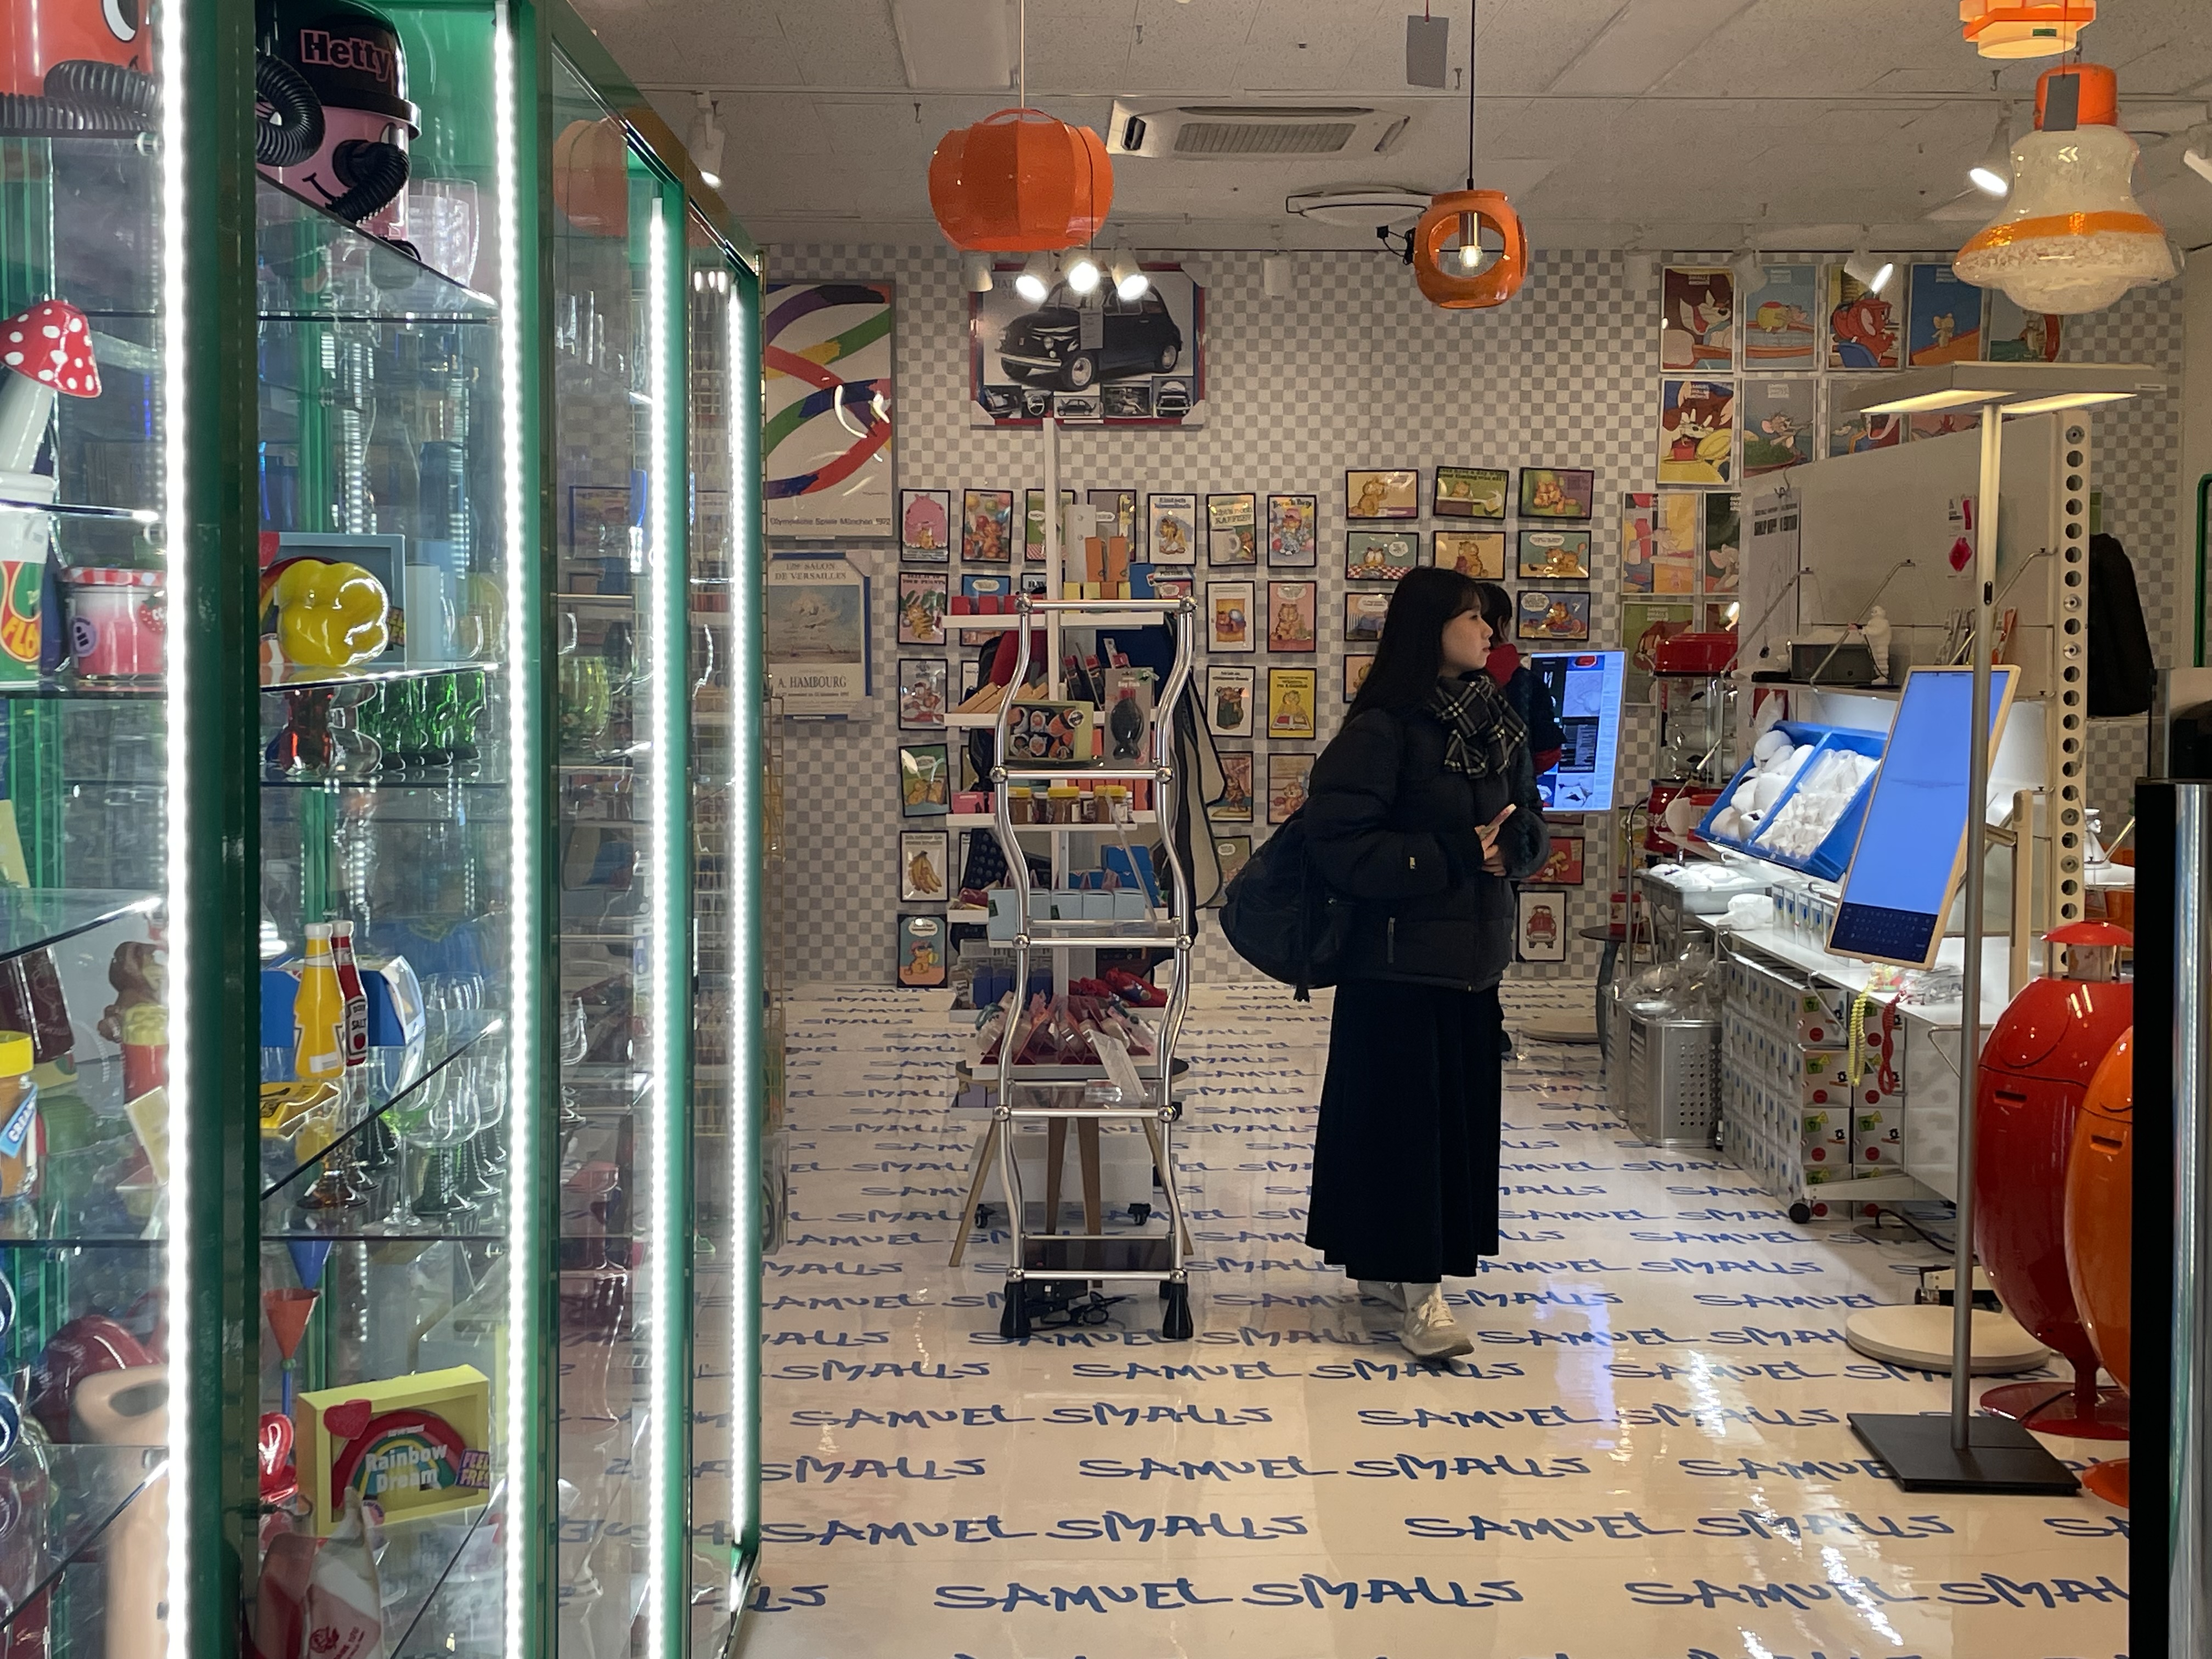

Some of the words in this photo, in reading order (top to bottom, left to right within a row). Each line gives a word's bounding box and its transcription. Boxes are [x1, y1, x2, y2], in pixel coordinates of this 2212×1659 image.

[301, 29, 393, 82] Hetty
[789, 676, 847, 689] HAMBOURG
[1629, 1229, 1824, 1244] SAMUEL
[762, 1262, 903, 1276] MALLS
[1642, 1258, 1825, 1274] SMALLS
[1692, 1293, 1909, 1309] SAMUEL
[1195, 1327, 1402, 1346] SMALLS
[1477, 1329, 1698, 1347] SAMUEL
[769, 1359, 992, 1381] SMALLS
[1072, 1361, 1304, 1380] SAMUEL
[1309, 1359, 1525, 1381] SMALLS
[789, 1404, 1035, 1429] SAMUEL
[1042, 1403, 1274, 1427] SMALLS
[1357, 1404, 1616, 1429] SAMUEL
[365, 1443, 448, 1472] Rainbow
[759, 1455, 987, 1485] SMALLS
[1079, 1455, 1339, 1482] SAMUEL
[1346, 1453, 1593, 1481] SMALLS
[1678, 1454, 1895, 1482] SAMUE
[376, 1469, 438, 1493] Dream
[759, 1514, 1039, 1546] SAMUEL
[1044, 1510, 1309, 1542] SMALLS
[1403, 1511, 1686, 1542] SAMUEL
[1692, 1509, 1955, 1541] SMALLS
[933, 1577, 1233, 1613] SAMUEL
[1241, 1573, 1525, 1610] SMALLS
[1623, 1577, 1928, 1611] SAMUEL
